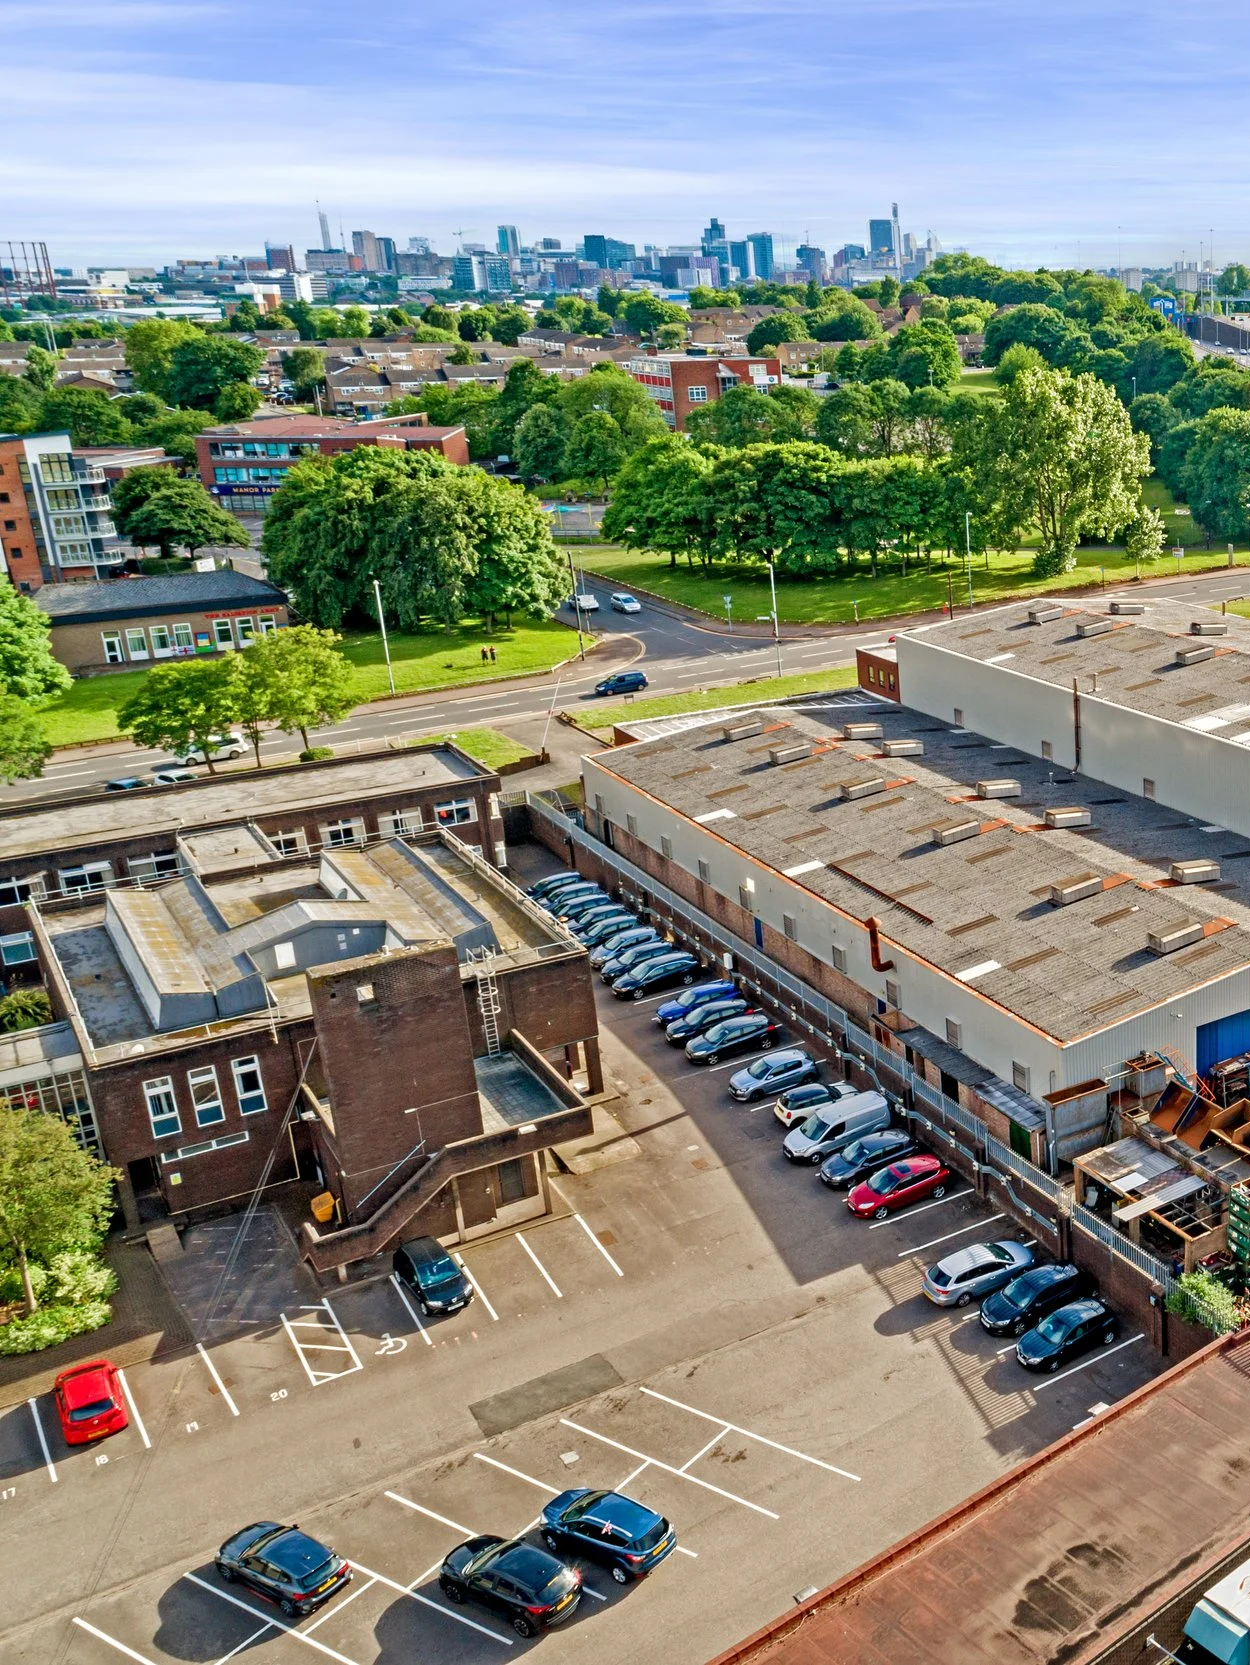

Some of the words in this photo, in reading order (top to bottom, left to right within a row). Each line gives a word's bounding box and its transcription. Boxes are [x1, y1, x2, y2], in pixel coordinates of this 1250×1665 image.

[270, 1388, 288, 1401] 20
[95, 1454, 109, 1466] 18
[1, 1487, 16, 1500] 17
